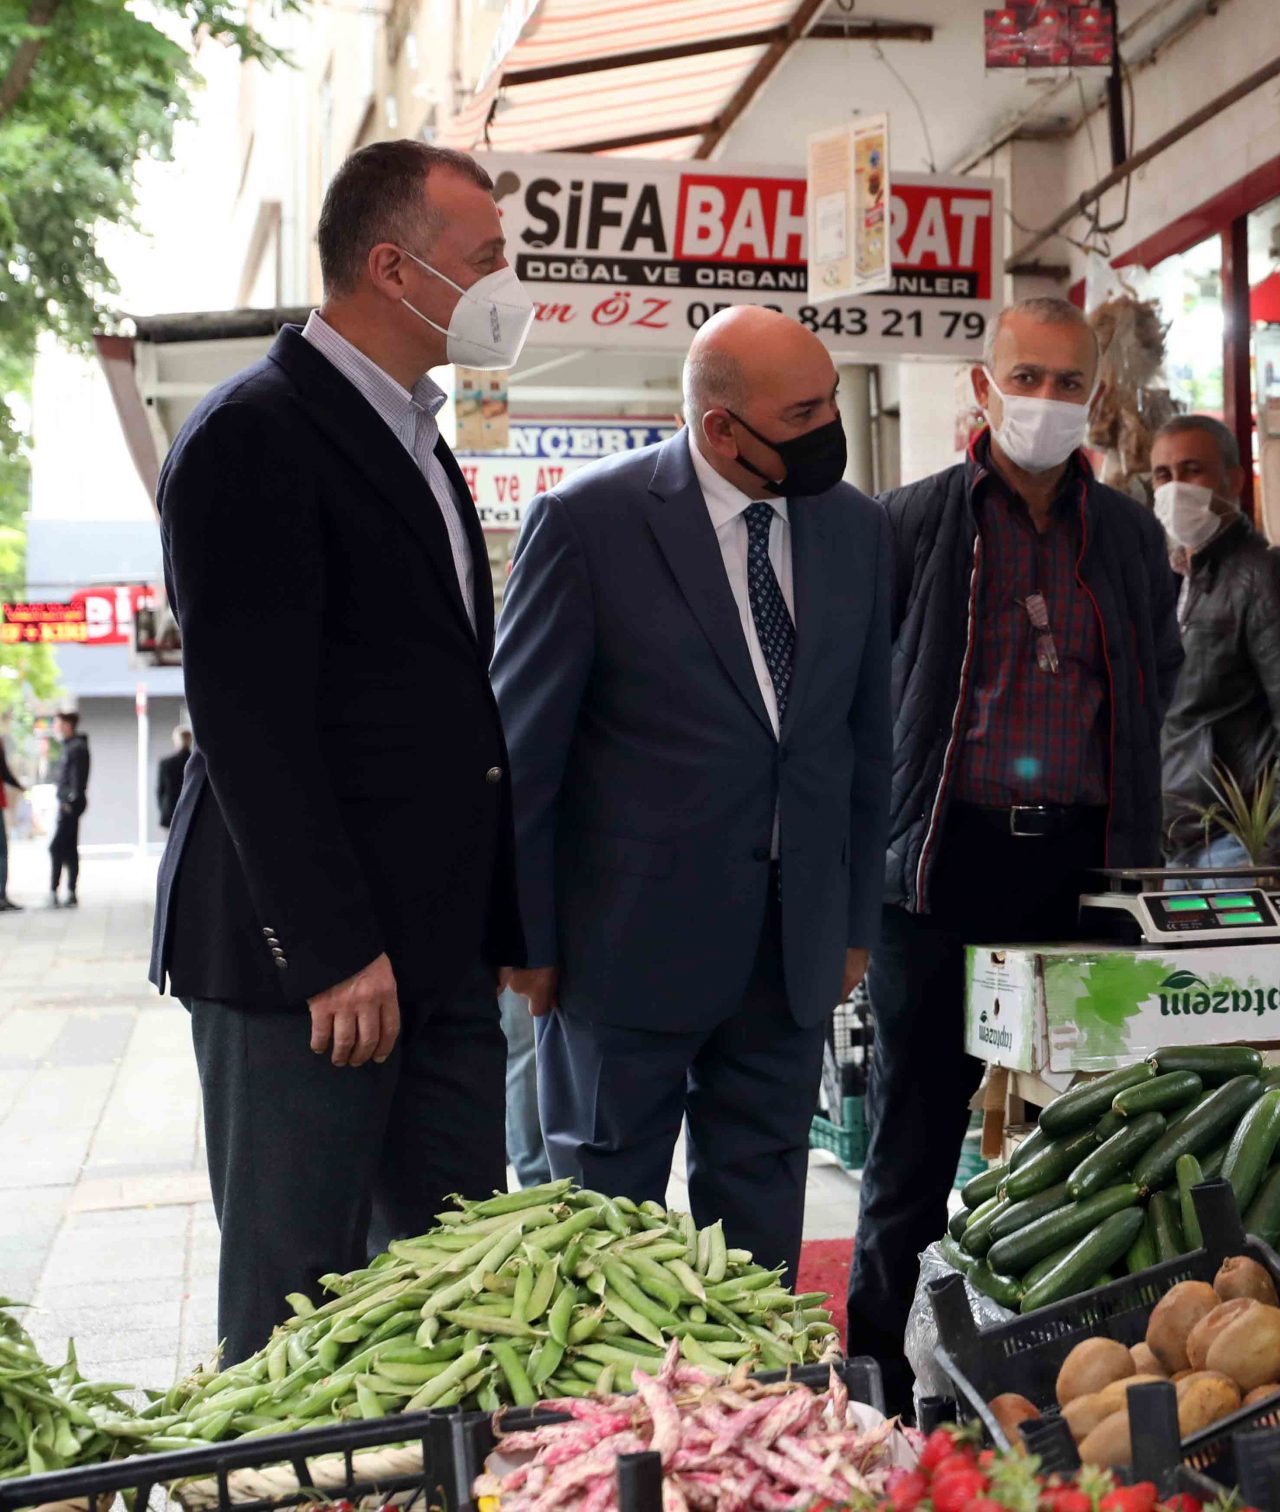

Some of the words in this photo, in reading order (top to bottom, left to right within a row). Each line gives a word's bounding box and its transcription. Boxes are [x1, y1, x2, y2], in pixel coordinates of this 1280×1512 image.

[682, 184, 990, 267] BAHRAT
[526, 259, 627, 282] DOĞAL
[643, 266, 681, 283] VE
[799, 306, 868, 335] 843
[881, 309, 922, 337] 21
[939, 310, 985, 339] 79
[495, 475, 519, 501] ve
